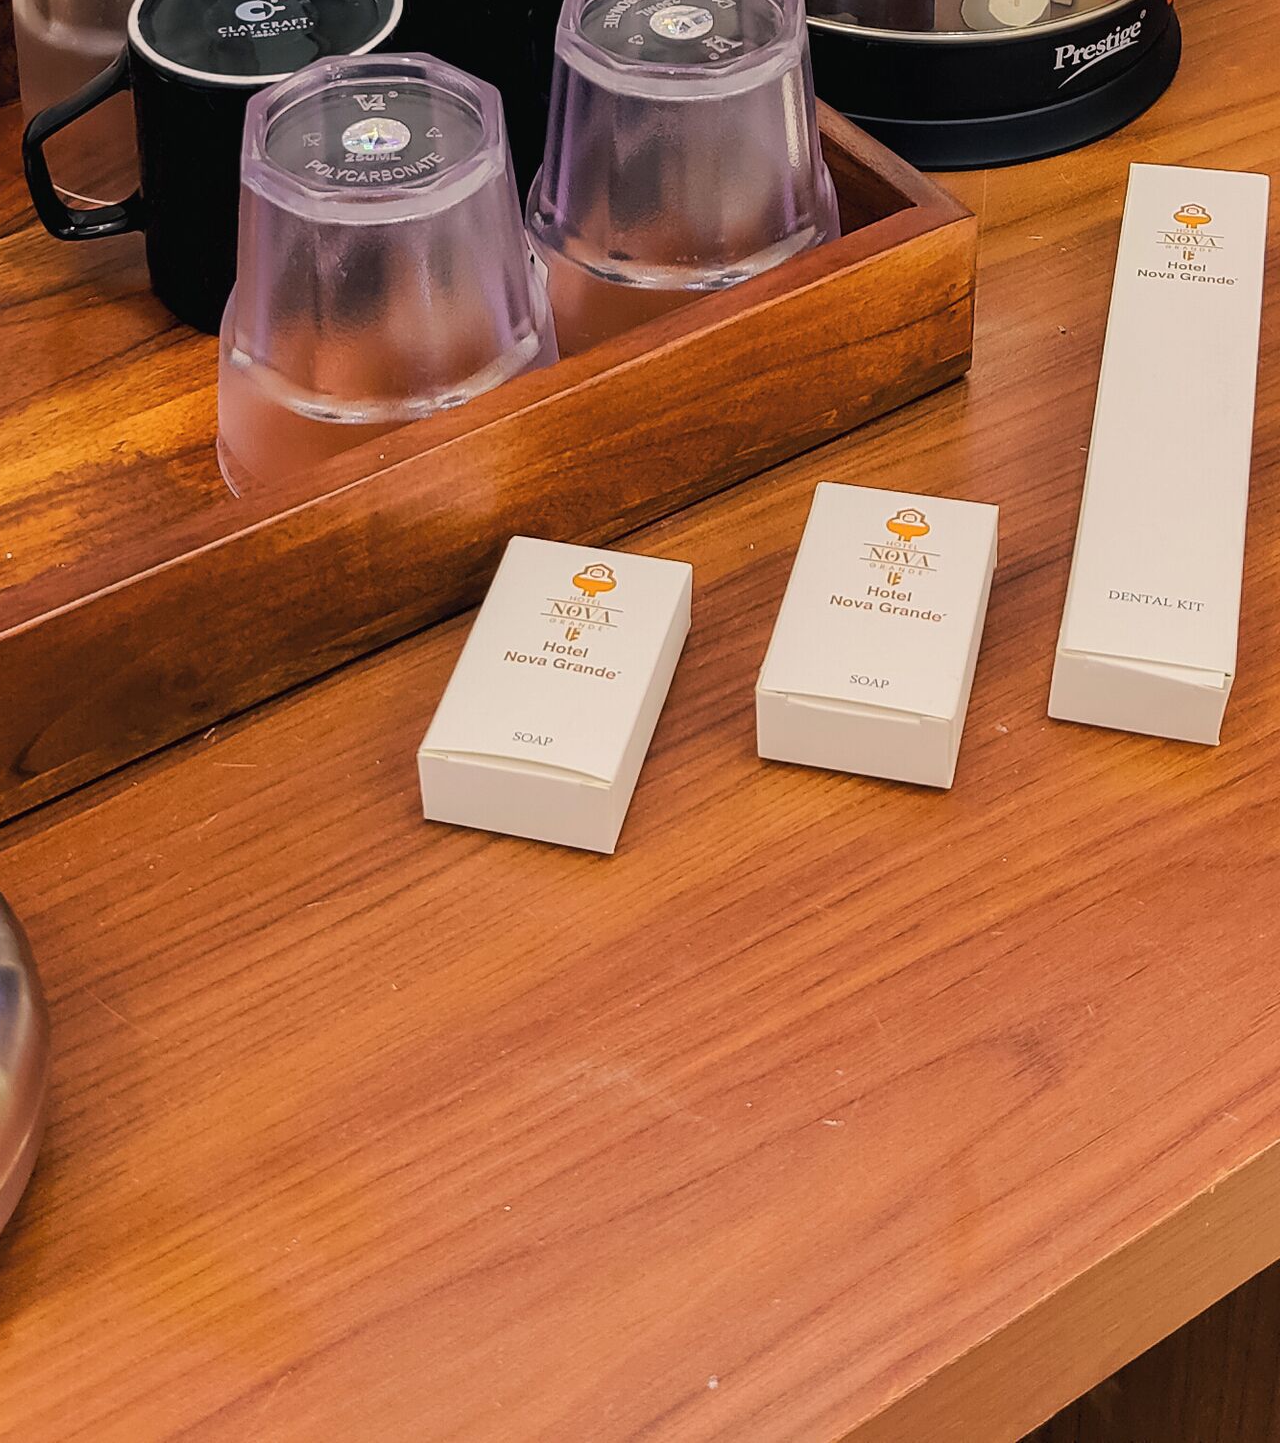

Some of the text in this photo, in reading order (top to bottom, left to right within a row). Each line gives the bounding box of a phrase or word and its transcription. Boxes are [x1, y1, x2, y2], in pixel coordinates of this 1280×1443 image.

[217, 17, 309, 34] CLAY CRAFT
[1053, 19, 1142, 71] Prestige
[305, 151, 446, 184] POLYCARBONATE
[1163, 233, 1216, 247] NOVA
[1167, 261, 1207, 273] Hotel
[1137, 269, 1236, 286] Nova Grande
[869, 546, 929, 567] NOVA
[866, 585, 913, 603] Hotel
[1108, 589, 1206, 613] DENTAL KIT
[550, 601, 611, 624] NOVA
[829, 595, 942, 623] Nova Grande
[542, 640, 590, 659] Hotel
[503, 650, 618, 681] Nova Grande
[849, 674, 891, 690] SOAP
[511, 730, 554, 748] SOAP
